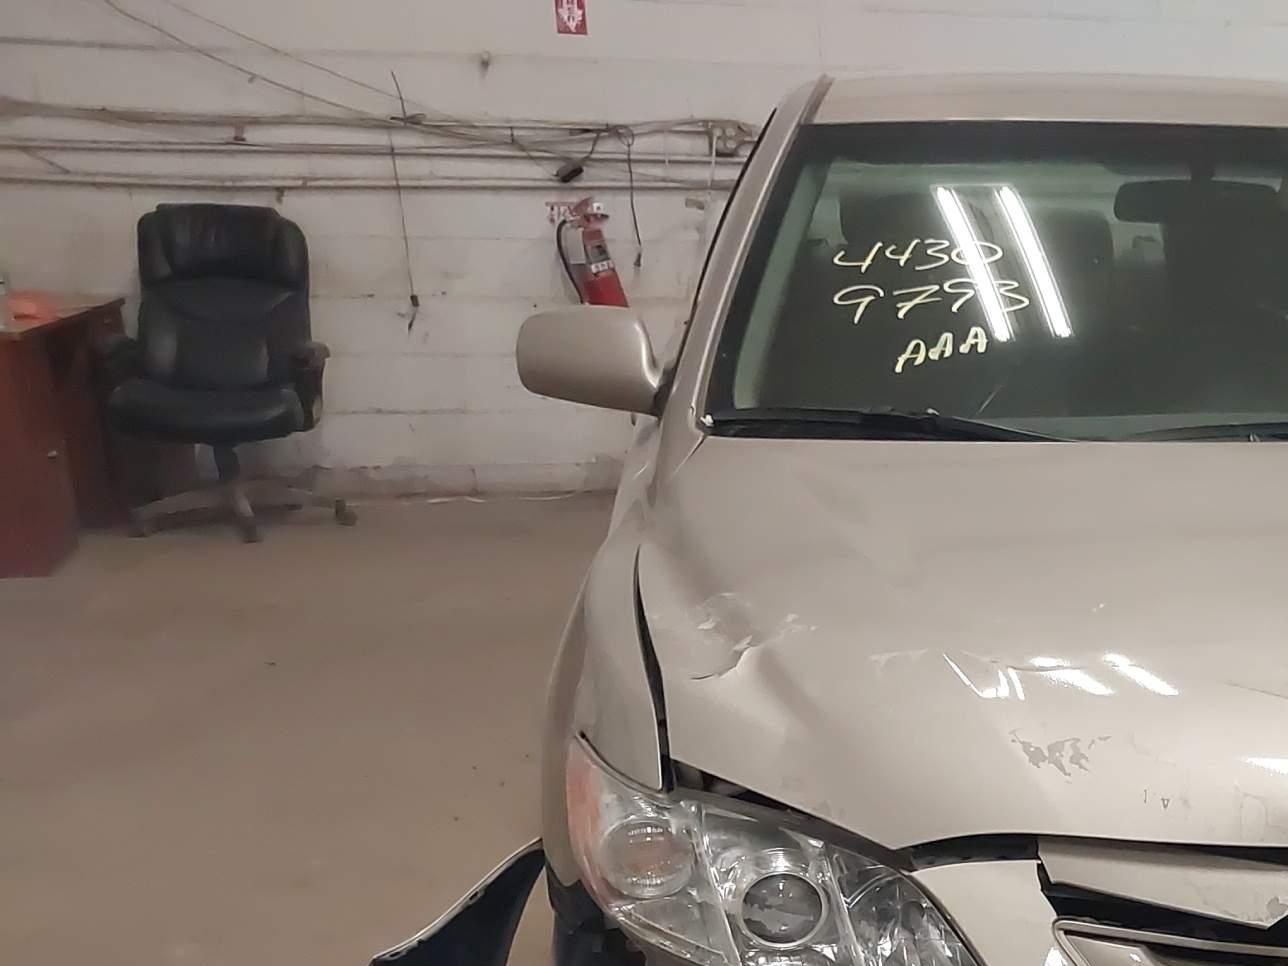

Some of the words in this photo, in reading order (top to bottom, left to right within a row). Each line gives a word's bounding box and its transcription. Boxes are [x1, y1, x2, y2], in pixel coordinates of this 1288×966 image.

[833, 238, 1004, 274] 4430
[833, 278, 1030, 324] 9793
[894, 326, 989, 373] AAA
